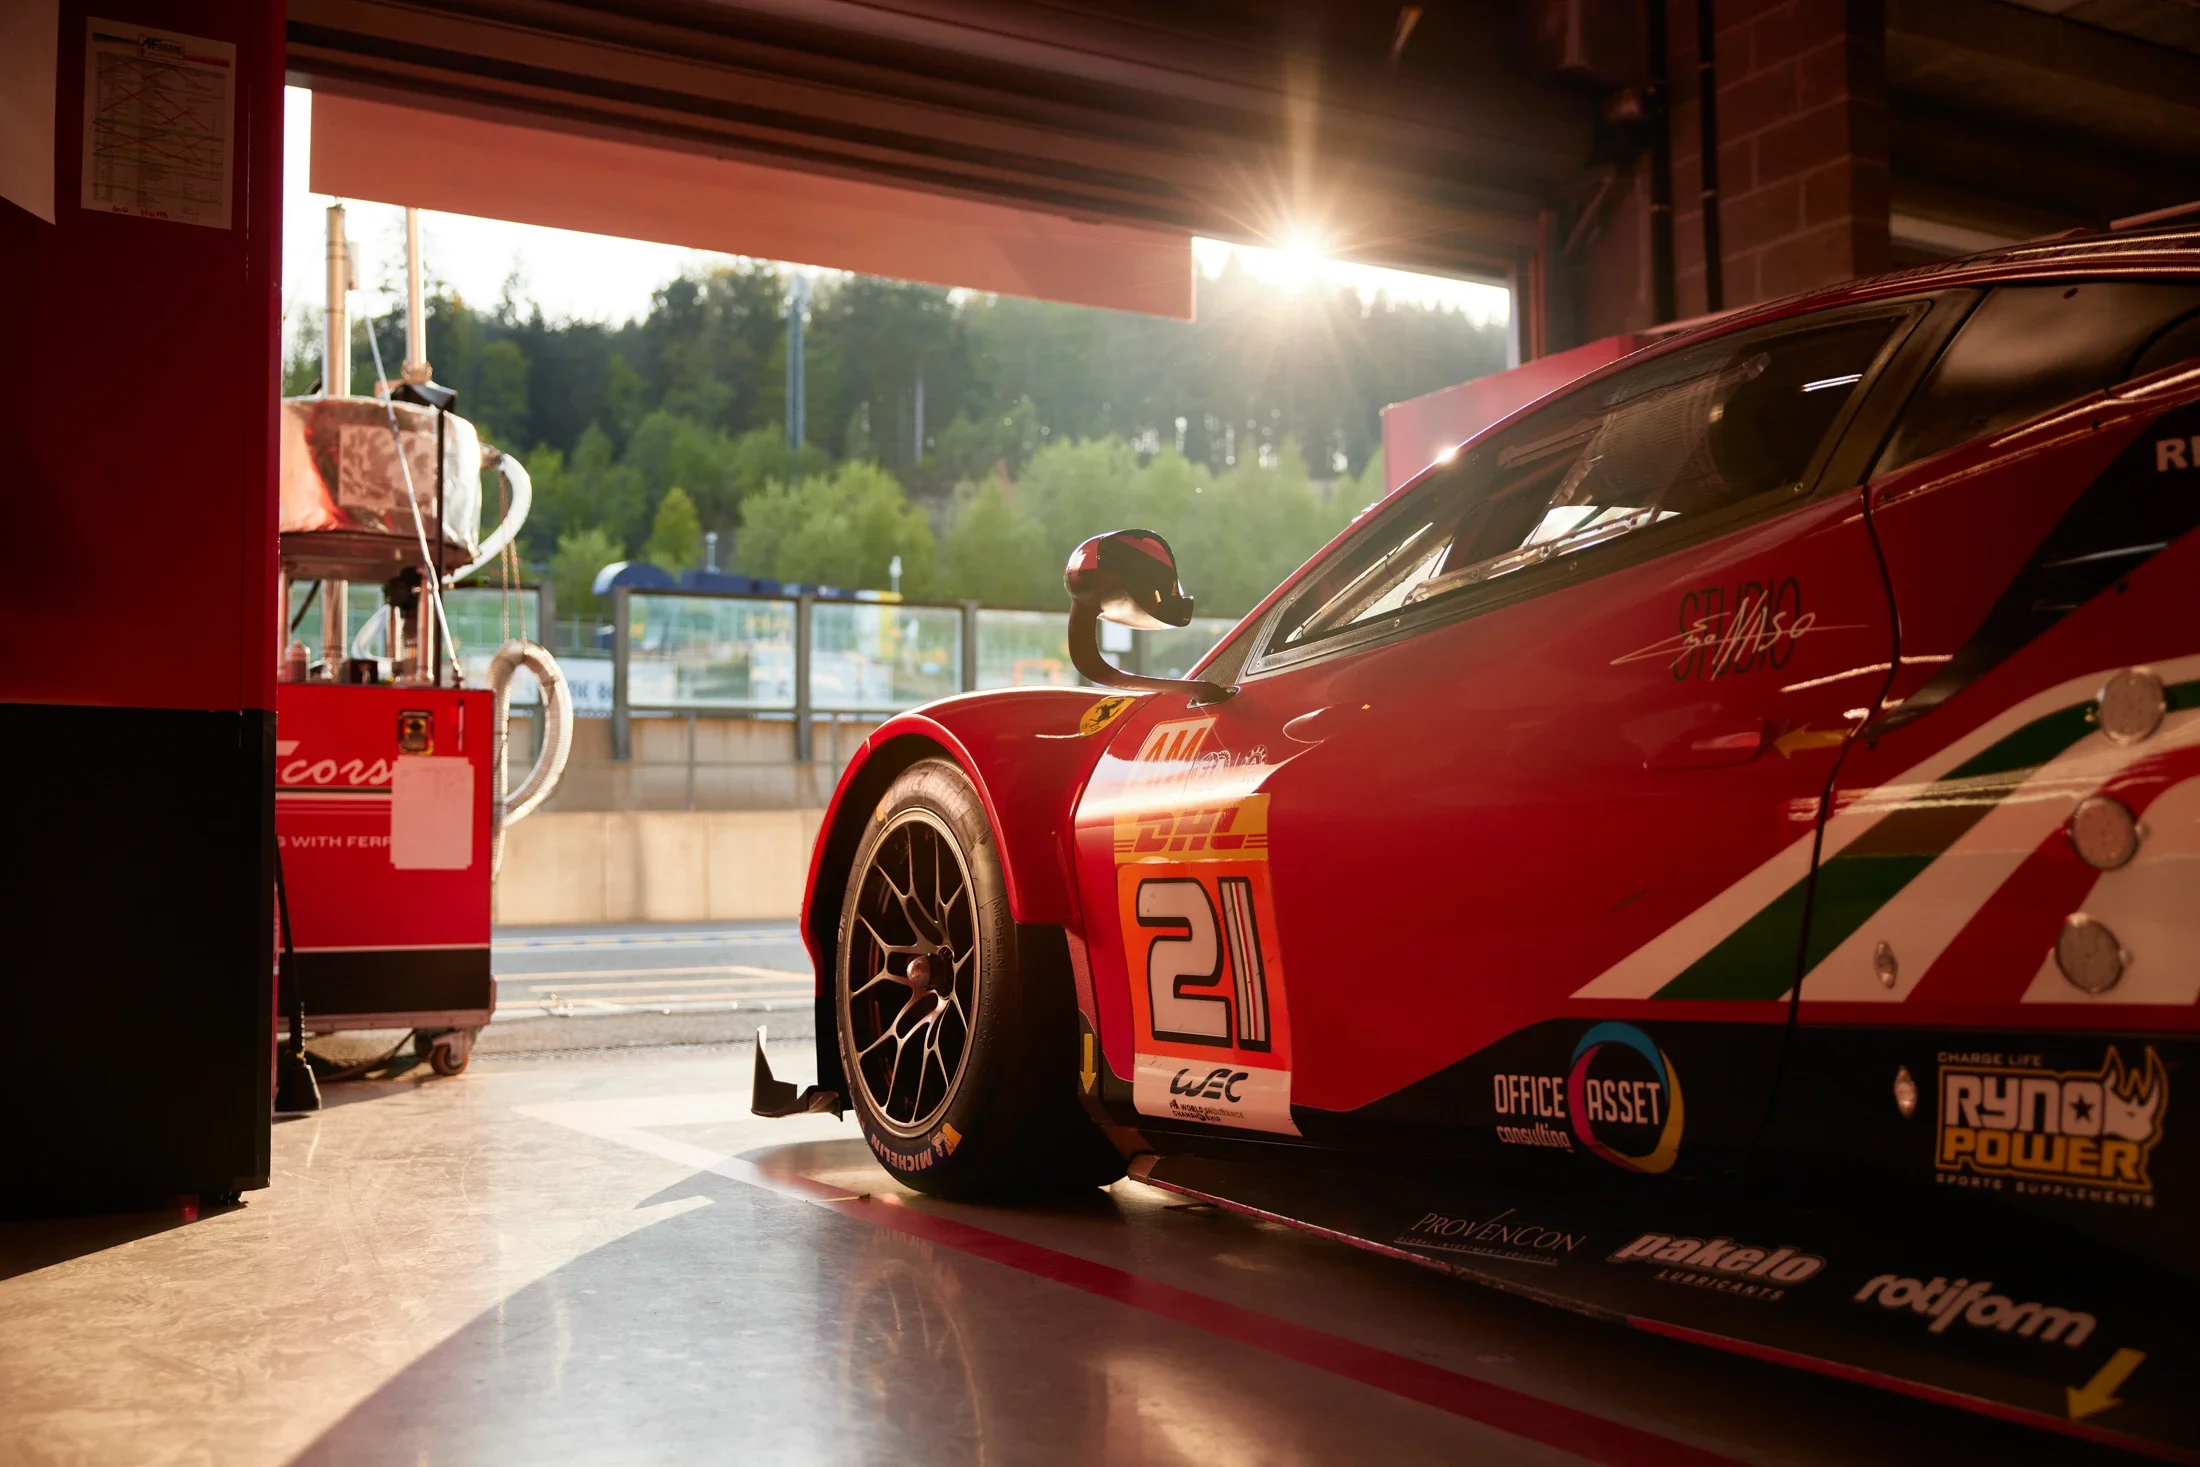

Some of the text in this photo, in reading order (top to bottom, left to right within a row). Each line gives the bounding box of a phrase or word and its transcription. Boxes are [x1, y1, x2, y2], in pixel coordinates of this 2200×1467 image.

[1672, 576, 1801, 682] STUDIO
[281, 758, 393, 785] cors
[291, 835, 342, 848] WITH
[1132, 806, 1246, 853] DHL
[993, 899, 1005, 967] MICHELIN
[1136, 876, 1271, 1053] 21
[1937, 1051, 2043, 1067] CHARGE LIFE
[1170, 1068, 1249, 1102] WEC
[1494, 1074, 1661, 1125] OFFICE ASSET
[1180, 1104, 1204, 1113] WORLD
[1204, 1107, 1245, 1119] ENDURANCE
[870, 1132, 933, 1172] MICHELIN
[1496, 1122, 1574, 1153] consulting
[1942, 1127, 2142, 1181] POWER
[1935, 1173, 2155, 1209] SPORTS SUPPLEMENTS
[1612, 1232, 1824, 1283] pakelo
[1657, 1269, 1785, 1301] LUBRICANTS
[1853, 1273, 2097, 1348] rotiform
